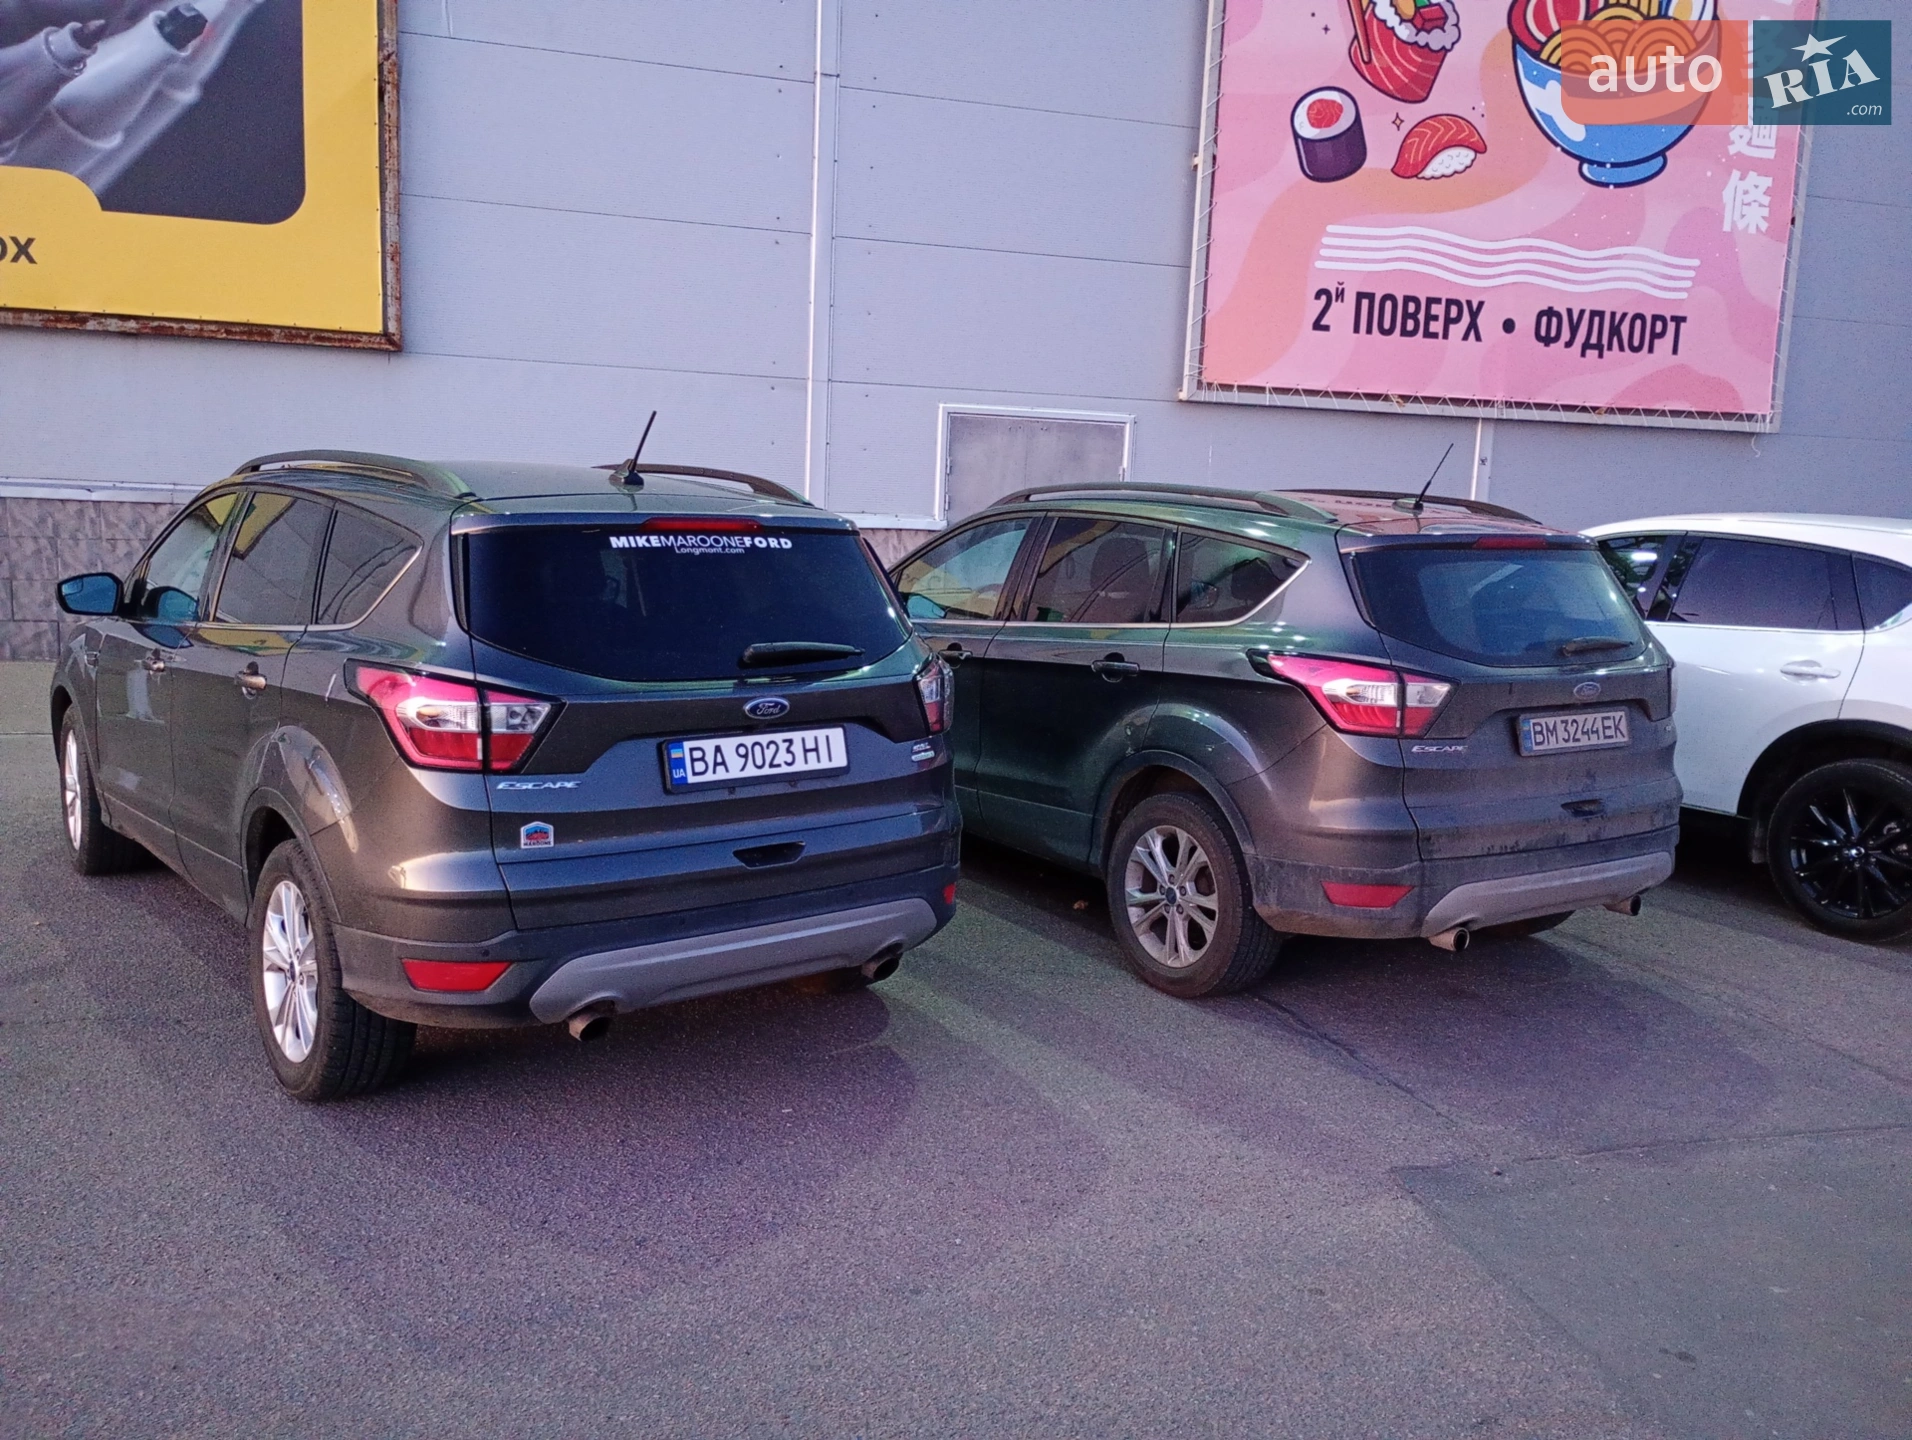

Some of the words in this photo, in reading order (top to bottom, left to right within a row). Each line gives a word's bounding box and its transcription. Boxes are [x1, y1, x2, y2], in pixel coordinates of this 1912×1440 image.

[1353, 291, 1485, 342] ПОВЕРХ
[1534, 306, 1687, 359] ФУДКОРТ
[675, 546, 745, 555] Longmont.com
[756, 702, 781, 715] Ford
[1532, 720, 1559, 746] BM
[1560, 717, 1600, 743] 3244
[1601, 715, 1625, 740] EK
[689, 745, 729, 776] BA
[735, 739, 796, 772] 9023
[802, 735, 832, 765] HI
[673, 769, 686, 779] UA
[496, 781, 582, 790] ESCAPE
